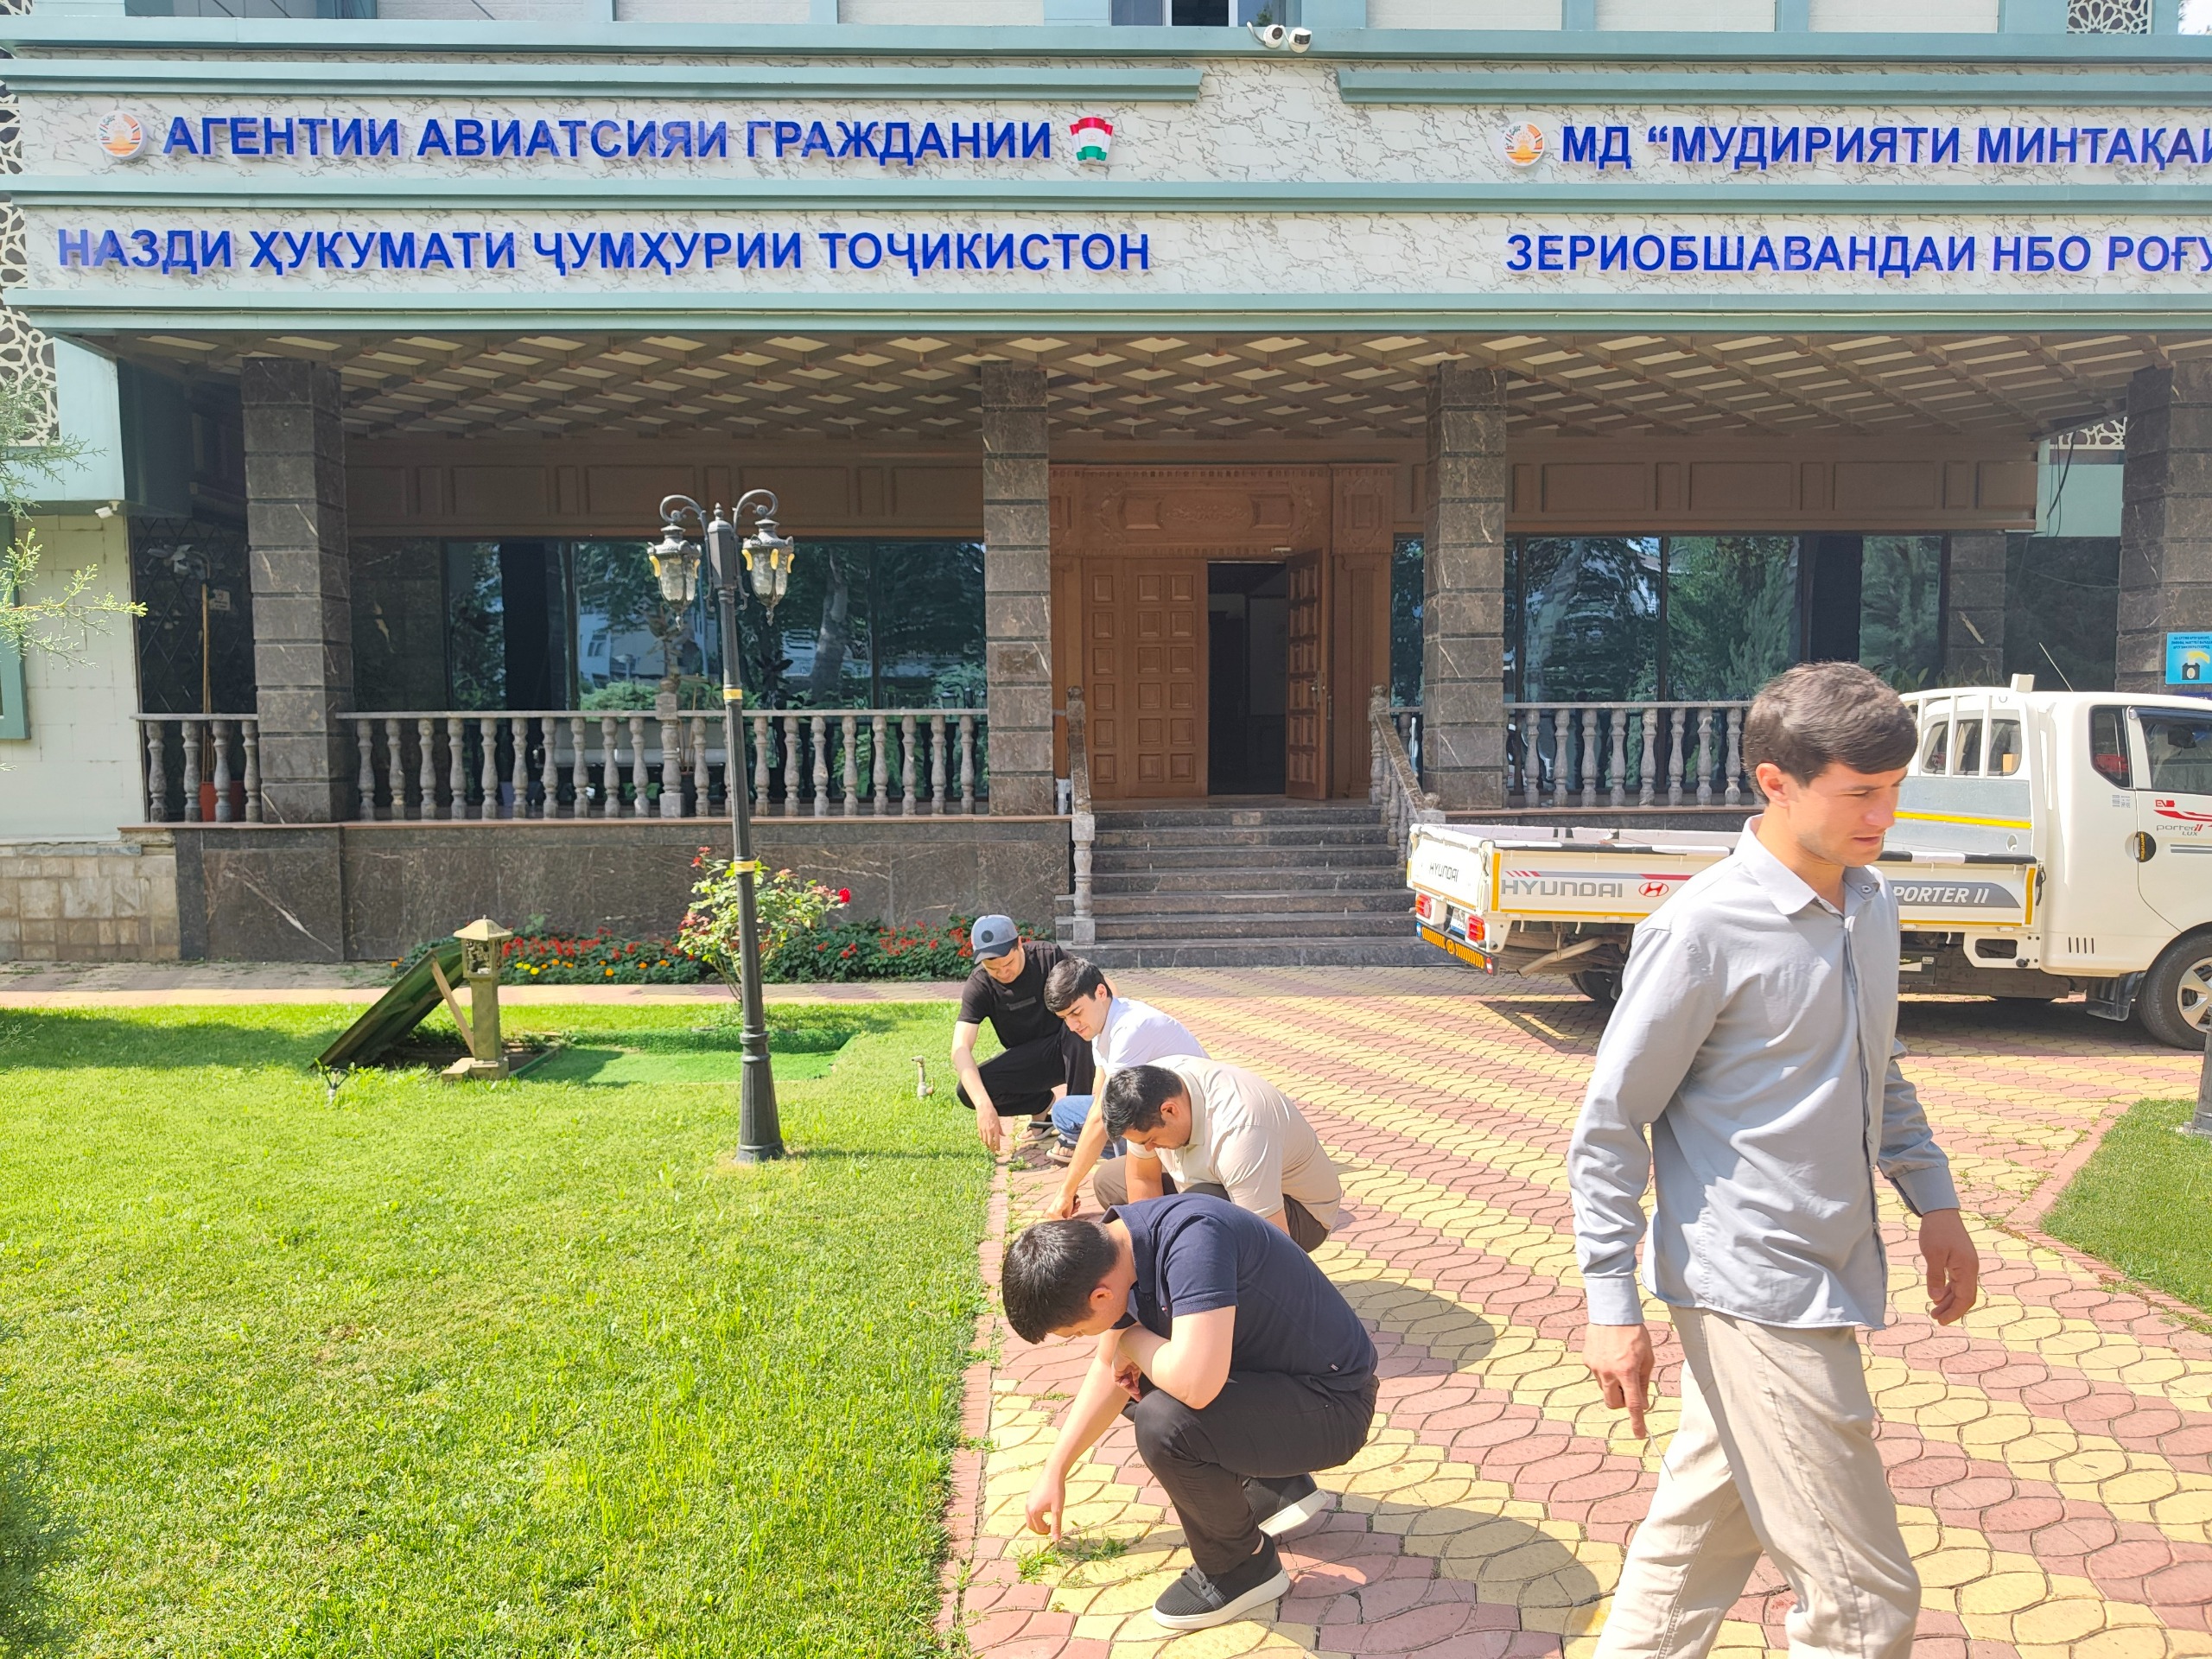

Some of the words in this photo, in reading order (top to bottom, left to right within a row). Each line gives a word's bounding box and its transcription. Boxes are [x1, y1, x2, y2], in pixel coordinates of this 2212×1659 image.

[163, 116, 400, 156] АГЕНТИИ
[416, 118, 728, 158] АВИАТСИЯИ
[747, 120, 1052, 167] ГРАЖДАНИИ
[1562, 125, 1632, 170] МД
[58, 228, 232, 276] НАЗДИ
[249, 230, 516, 276] ҲУКУМАТИ
[533, 231, 802, 277] ҶУМҲУРИИ
[817, 231, 1149, 277] ТОҶИКИСТОН
[1506, 233, 1976, 279] ЗЕРИОБШАВАНДАИ
[1993, 234, 2092, 272] НБО
[1429, 862, 1459, 882] HYUNDAI
[1501, 880, 1623, 898] HYUNDAI
[1893, 886, 1969, 904] PORTER
